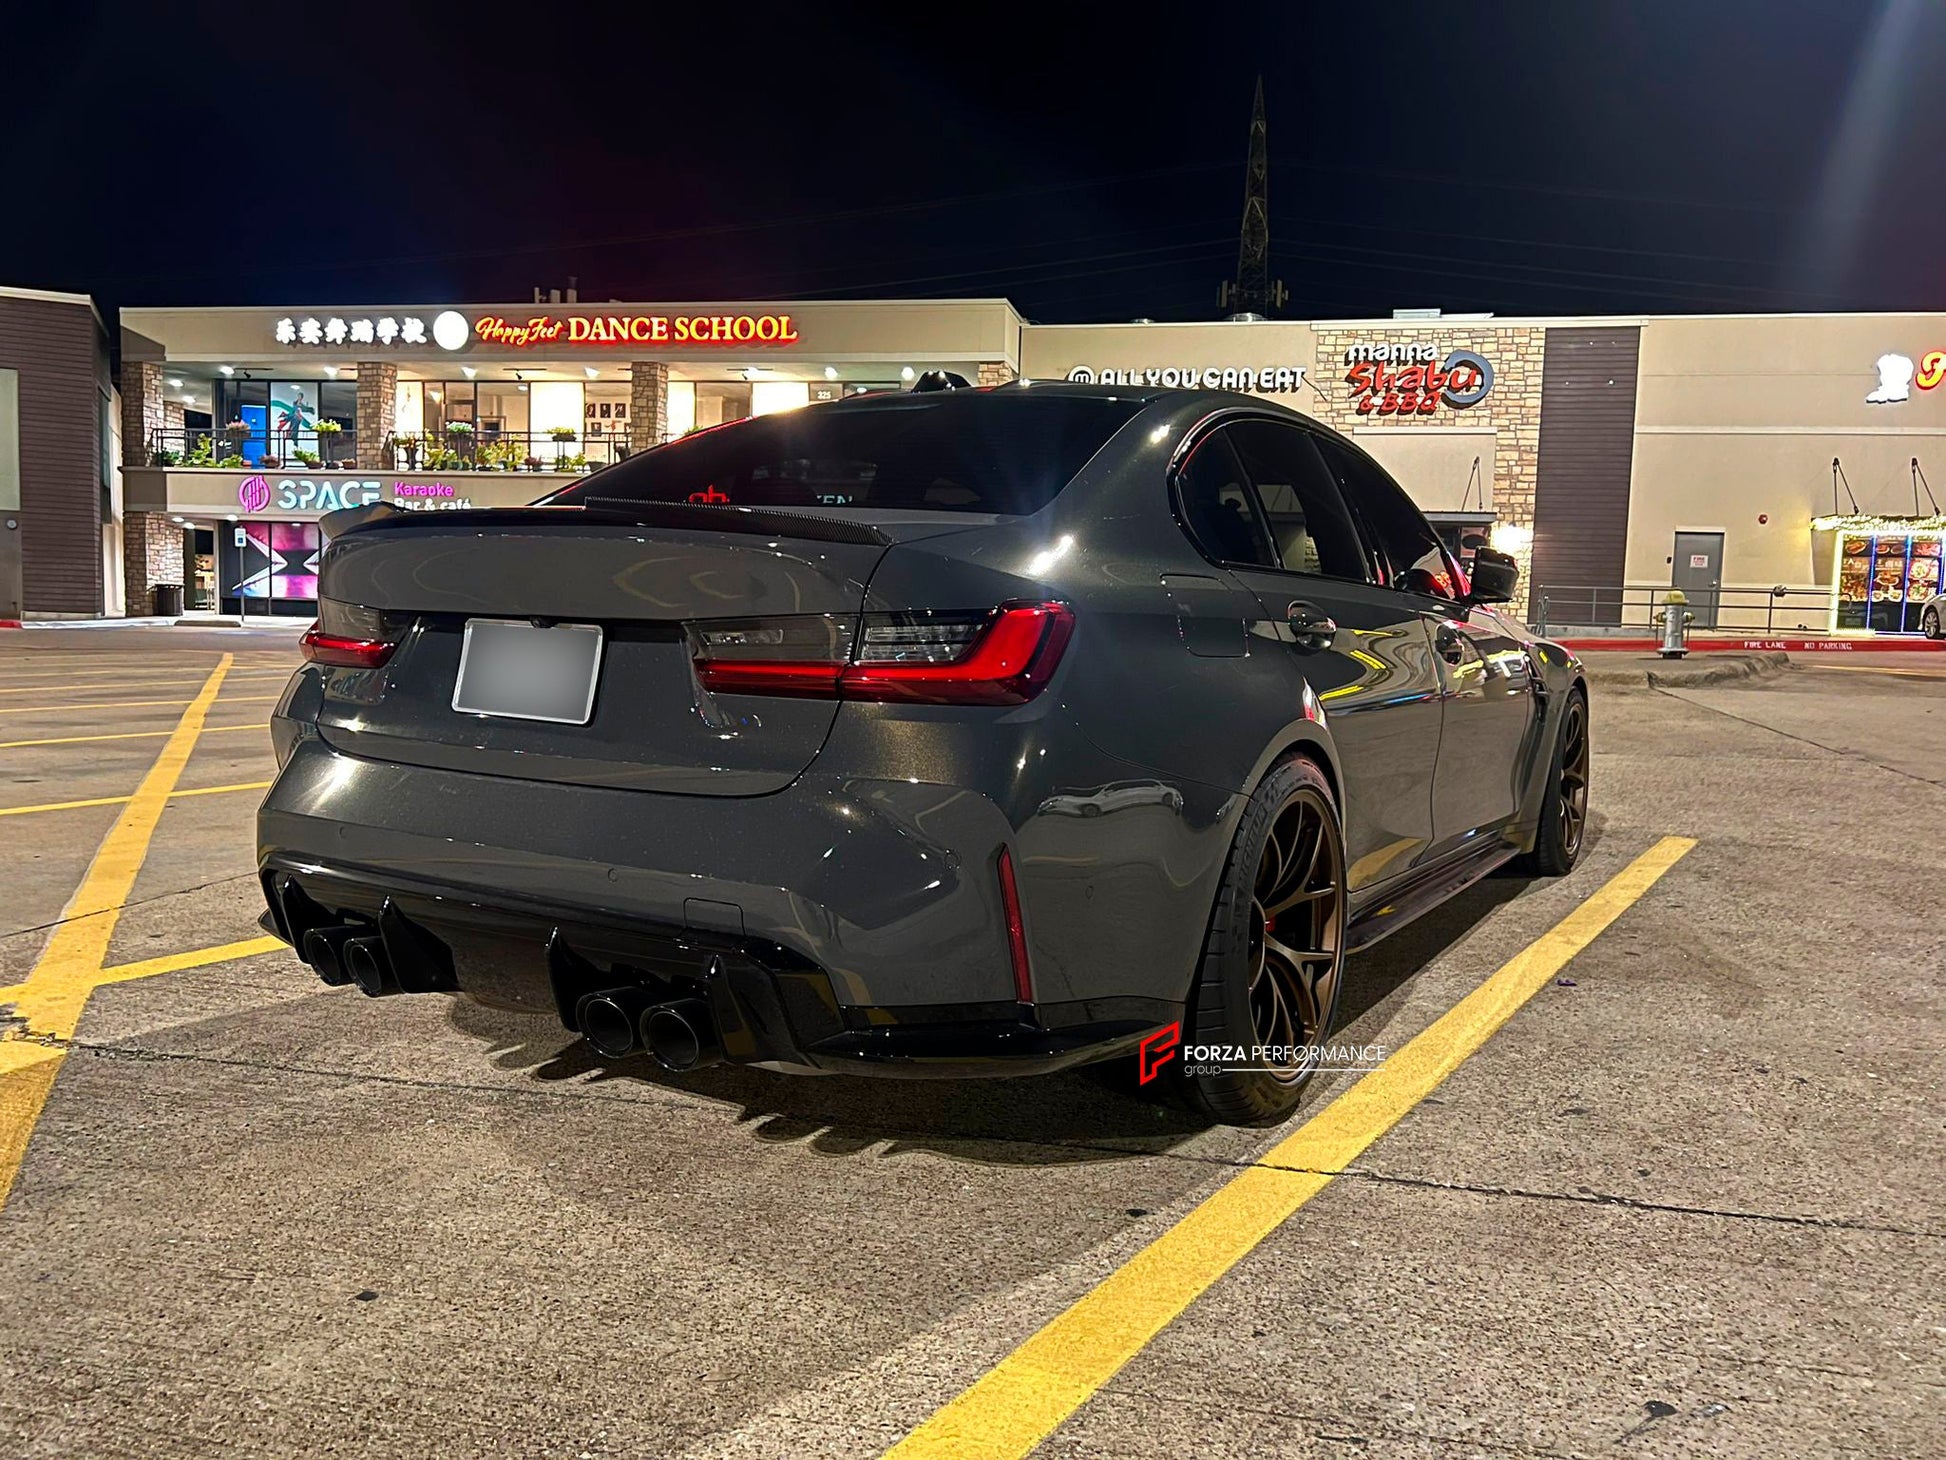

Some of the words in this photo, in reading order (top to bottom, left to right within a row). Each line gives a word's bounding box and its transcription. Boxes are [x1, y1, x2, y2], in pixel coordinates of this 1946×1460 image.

[475, 316, 530, 345] Happy
[528, 316, 563, 342] Feet
[567, 316, 669, 341] DANCE
[674, 315, 798, 341] SCHOOL
[1347, 343, 1439, 361] manna
[1101, 368, 1143, 385] ALL
[1146, 367, 1197, 388] YOU
[1203, 367, 1254, 388] CAN
[1259, 367, 1307, 389] EAT
[1348, 360, 1478, 397] Shabu
[1380, 392, 1441, 412] BBQ
[277, 479, 382, 509] SPACE
[394, 481, 454, 496] Karaoke
[1743, 641, 1762, 649] FIRE
[1765, 641, 1787, 649] LANE
[1804, 642, 1815, 650] NO
[1818, 642, 1853, 650] PARKING
